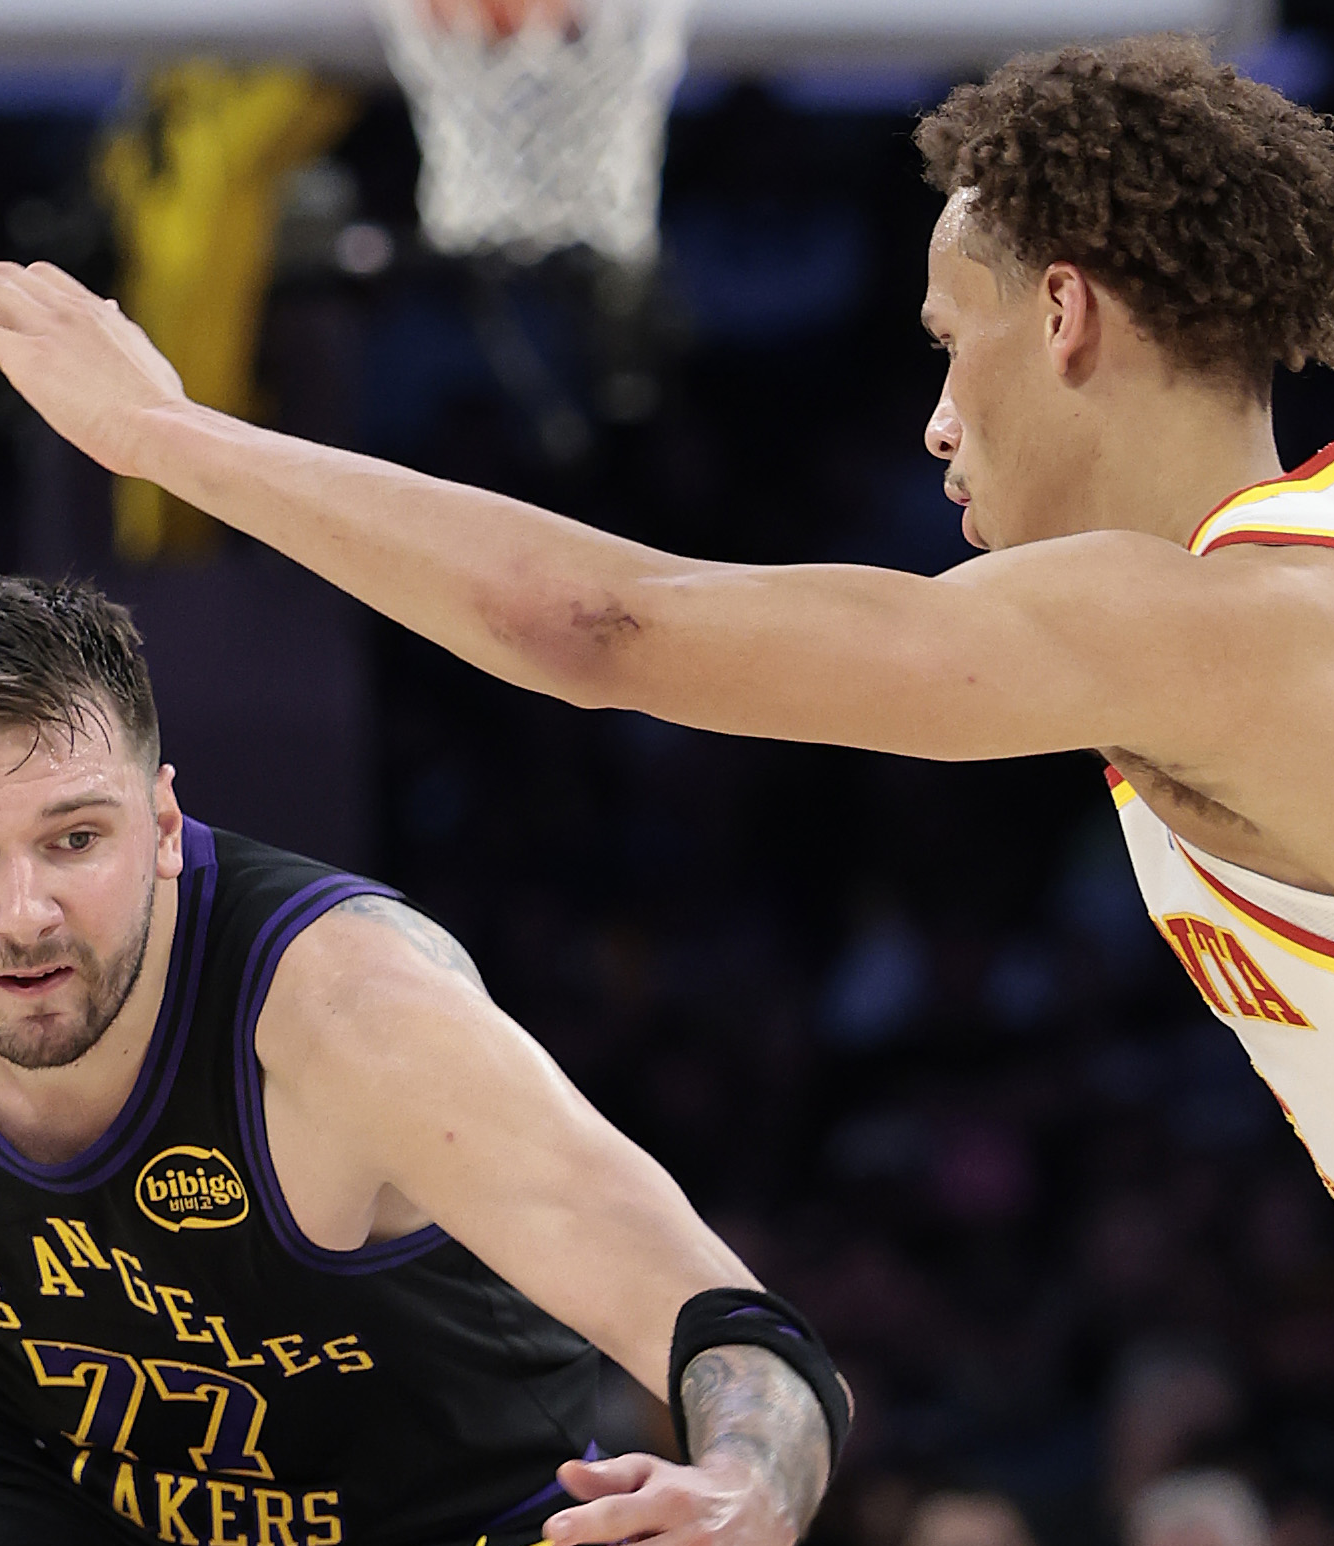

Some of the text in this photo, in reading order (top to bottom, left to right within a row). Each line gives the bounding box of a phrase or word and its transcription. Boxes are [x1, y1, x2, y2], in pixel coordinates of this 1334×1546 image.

[145, 1167, 243, 1206] bibigo
[31, 1217, 375, 1377] ANGELES
[20, 1338, 275, 1480] 77
